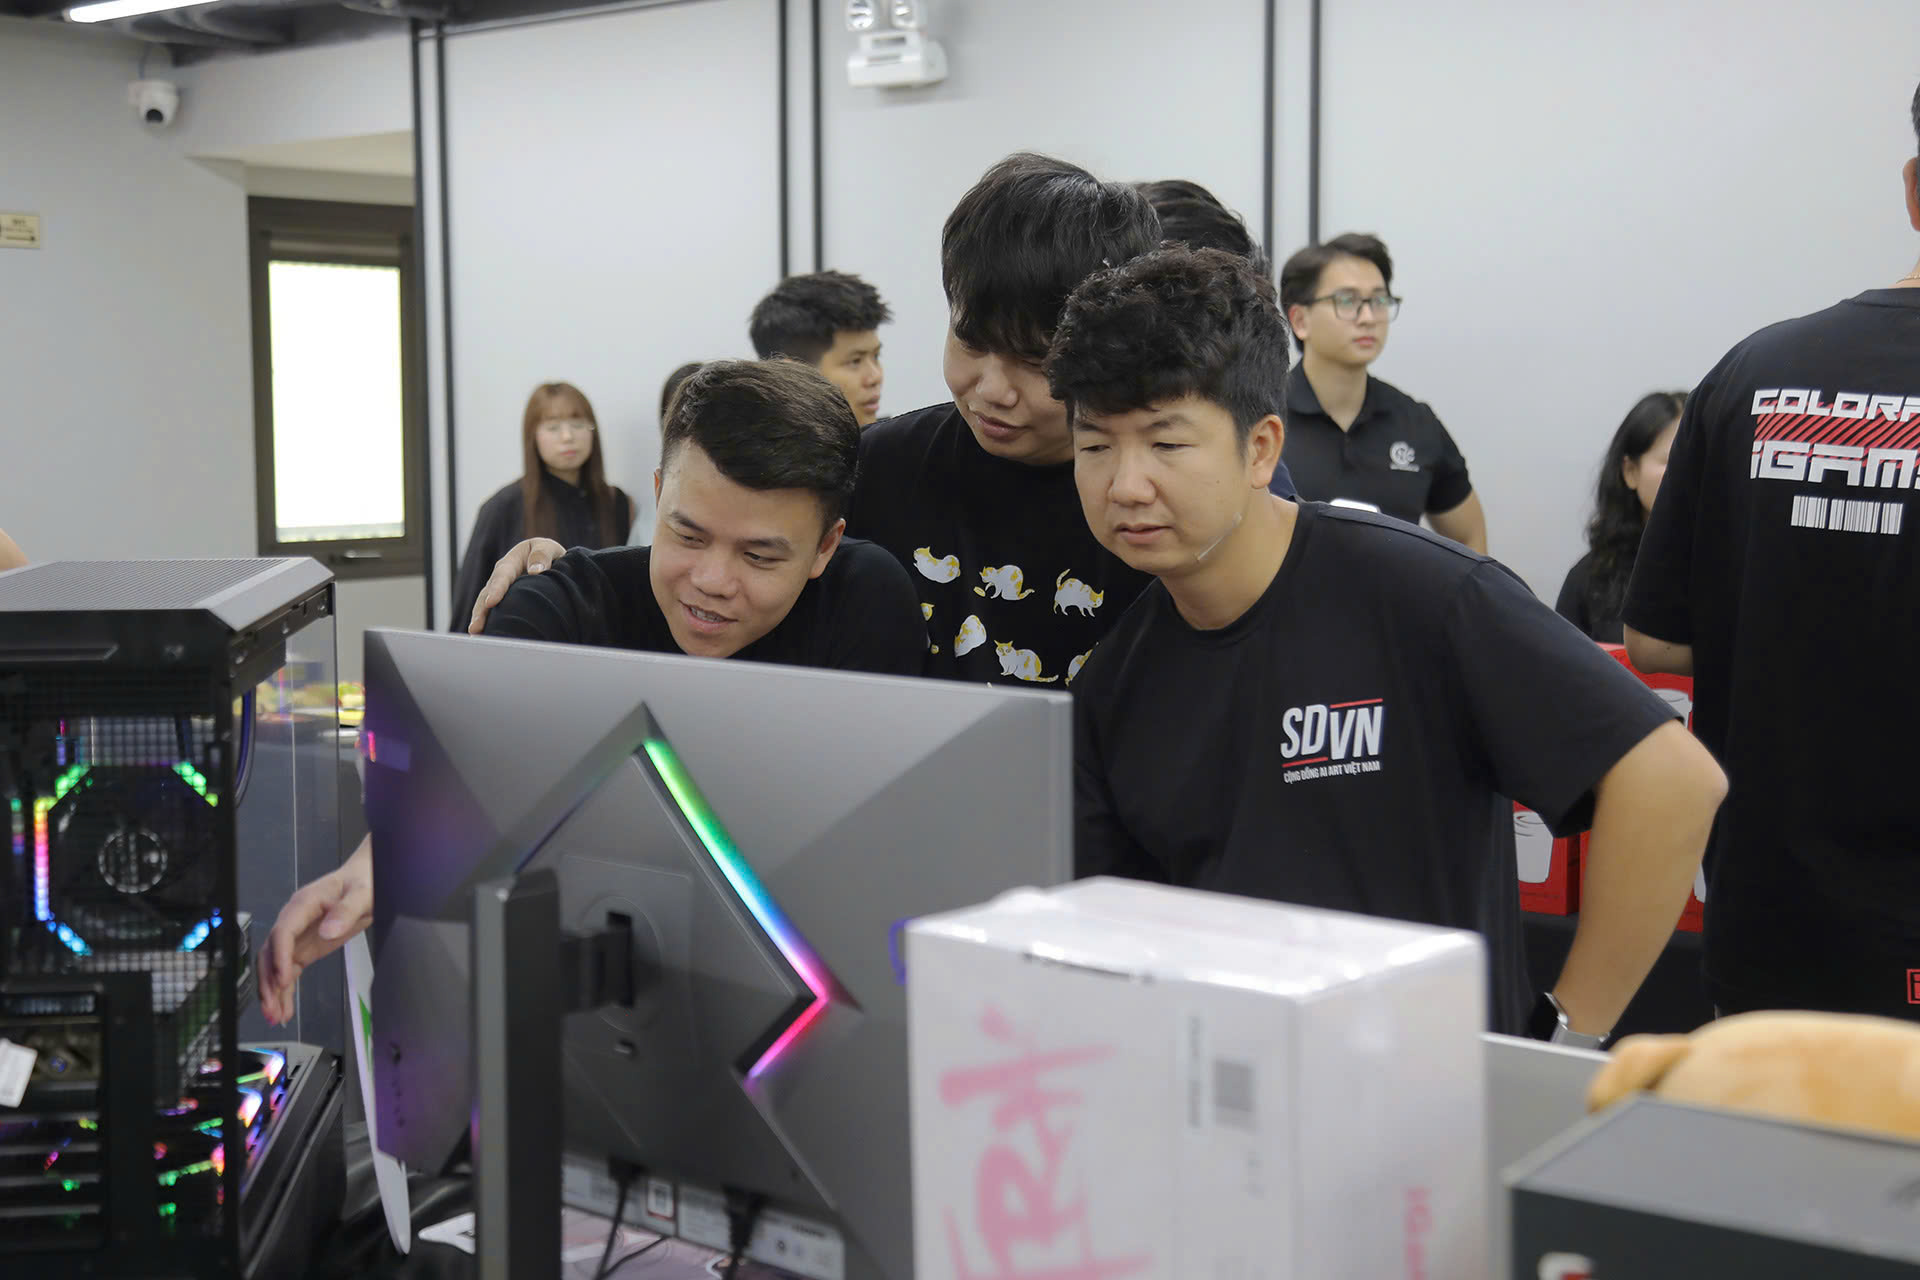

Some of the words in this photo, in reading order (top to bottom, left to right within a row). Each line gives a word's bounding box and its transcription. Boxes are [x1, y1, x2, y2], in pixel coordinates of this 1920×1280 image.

[1280, 704, 1383, 760] SDVN
[1319, 767, 1328, 777] AI
[1328, 764, 1343, 776] ART
[1342, 760, 1361, 775] VIỆT
[1361, 760, 1381, 772] NAM
